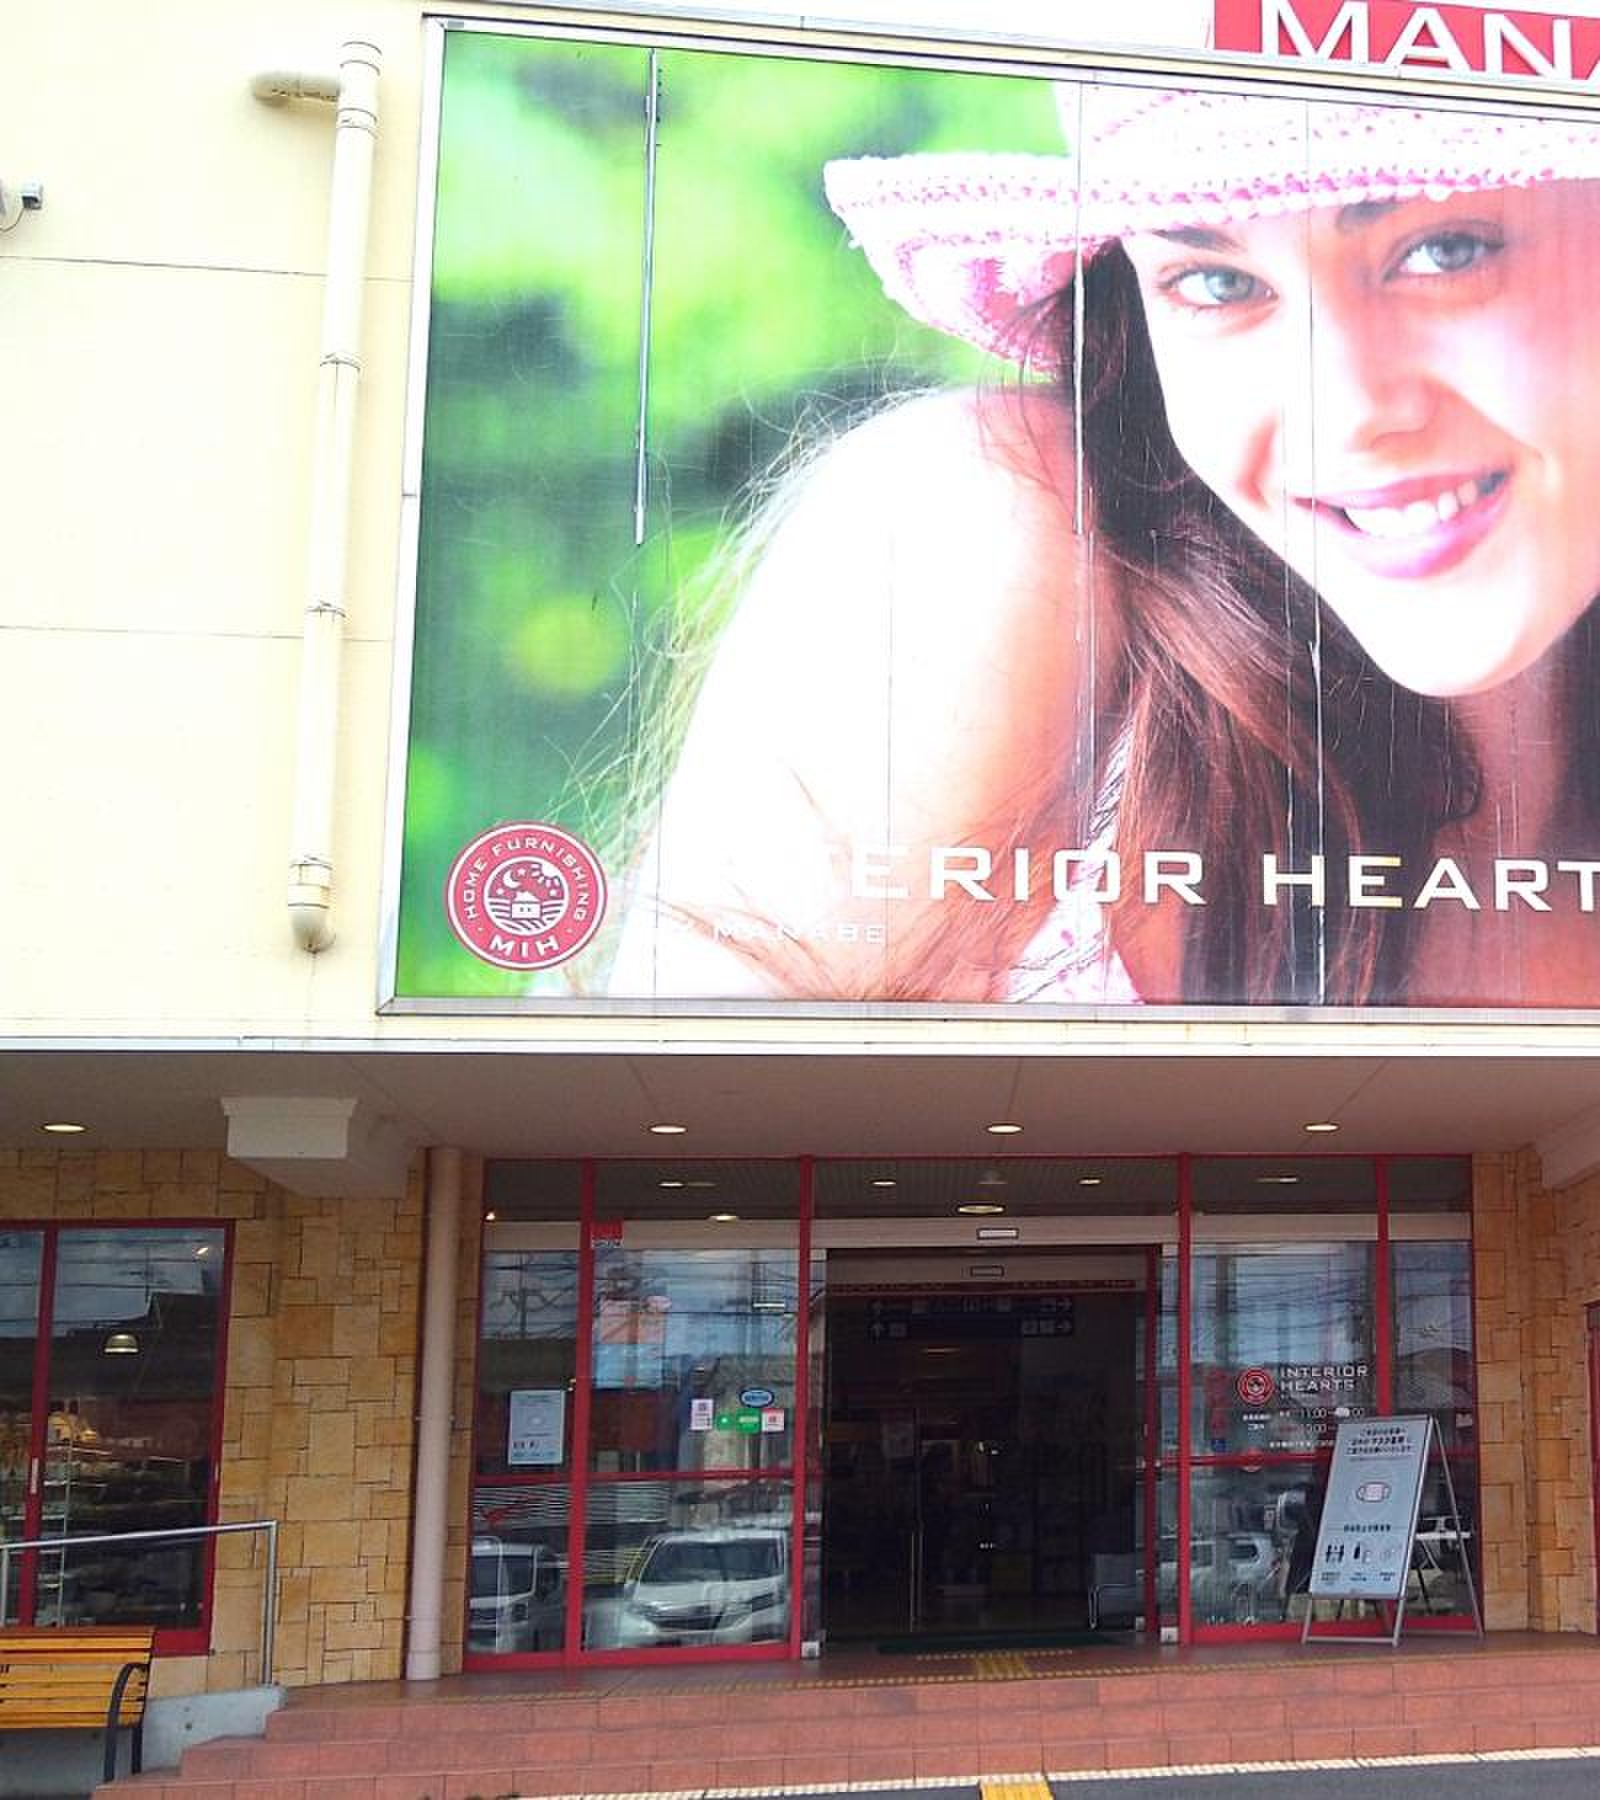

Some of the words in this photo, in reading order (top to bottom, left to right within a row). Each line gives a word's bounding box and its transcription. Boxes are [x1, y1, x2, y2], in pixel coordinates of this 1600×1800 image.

[464, 858, 487, 919] HOME
[491, 837, 590, 921] FURNISHING
[489, 934, 559, 957] MIH
[1280, 1364, 1369, 1377] INTERIOR
[1280, 1379, 1355, 1391] HEARTS
